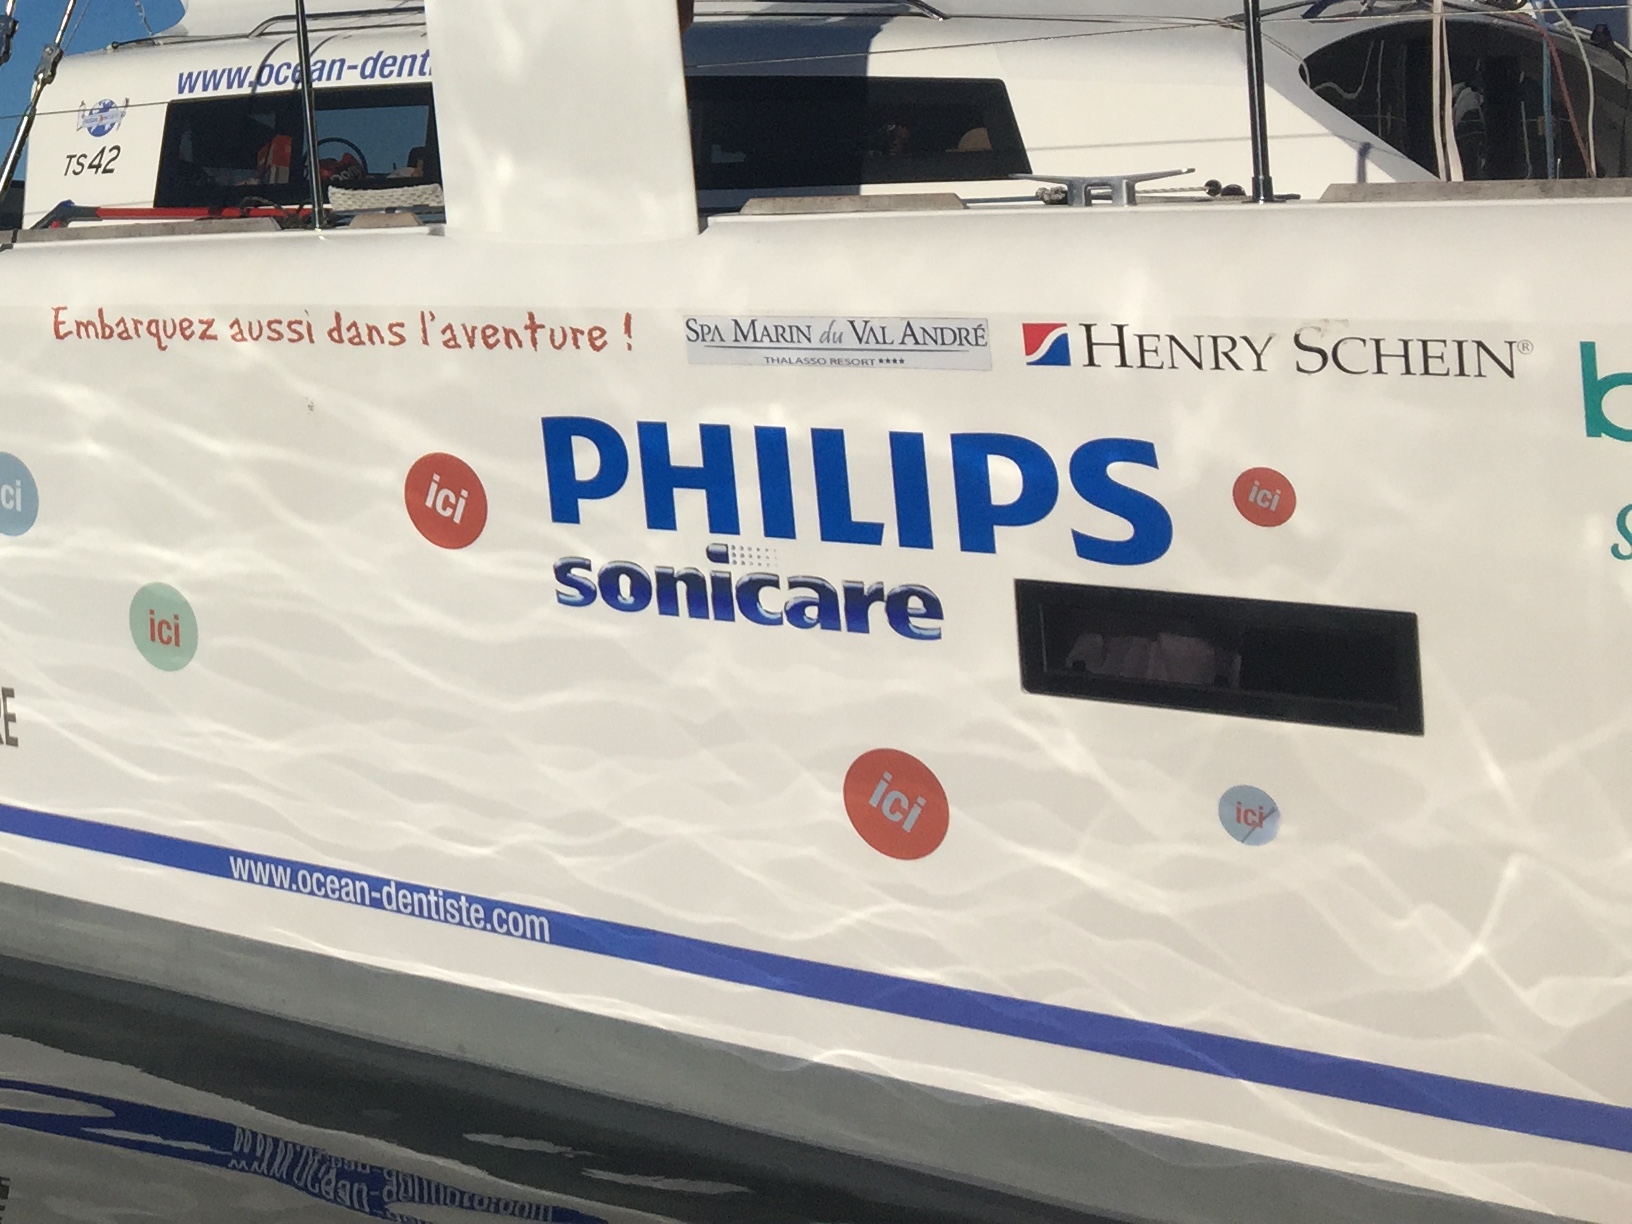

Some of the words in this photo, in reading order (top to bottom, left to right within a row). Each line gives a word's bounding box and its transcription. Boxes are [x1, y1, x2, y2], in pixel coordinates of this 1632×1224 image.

[177, 48, 432, 95] www.ocean-dent
[51, 306, 218, 352] Embarquez
[230, 310, 316, 345] aussi
[326, 311, 407, 346] dans
[421, 310, 608, 352] l'aventure
[685, 318, 726, 343] SPA
[731, 318, 812, 344] MARIN
[819, 319, 844, 345] du
[847, 319, 895, 345] VAL
[898, 320, 988, 347] ANDRÉ
[1079, 323, 1275, 372] HENRY
[764, 356, 827, 366] THALASSO
[830, 357, 876, 367] RESORT
[423, 473, 469, 525] ici
[541, 416, 1173, 566] PHILIPS
[1248, 480, 1282, 512] ici
[553, 543, 943, 641] sonicare
[148, 609, 181, 647] ici
[868, 771, 928, 834] ici
[1235, 800, 1265, 830] ici
[228, 855, 551, 943] www.ocean-dentiste.com
